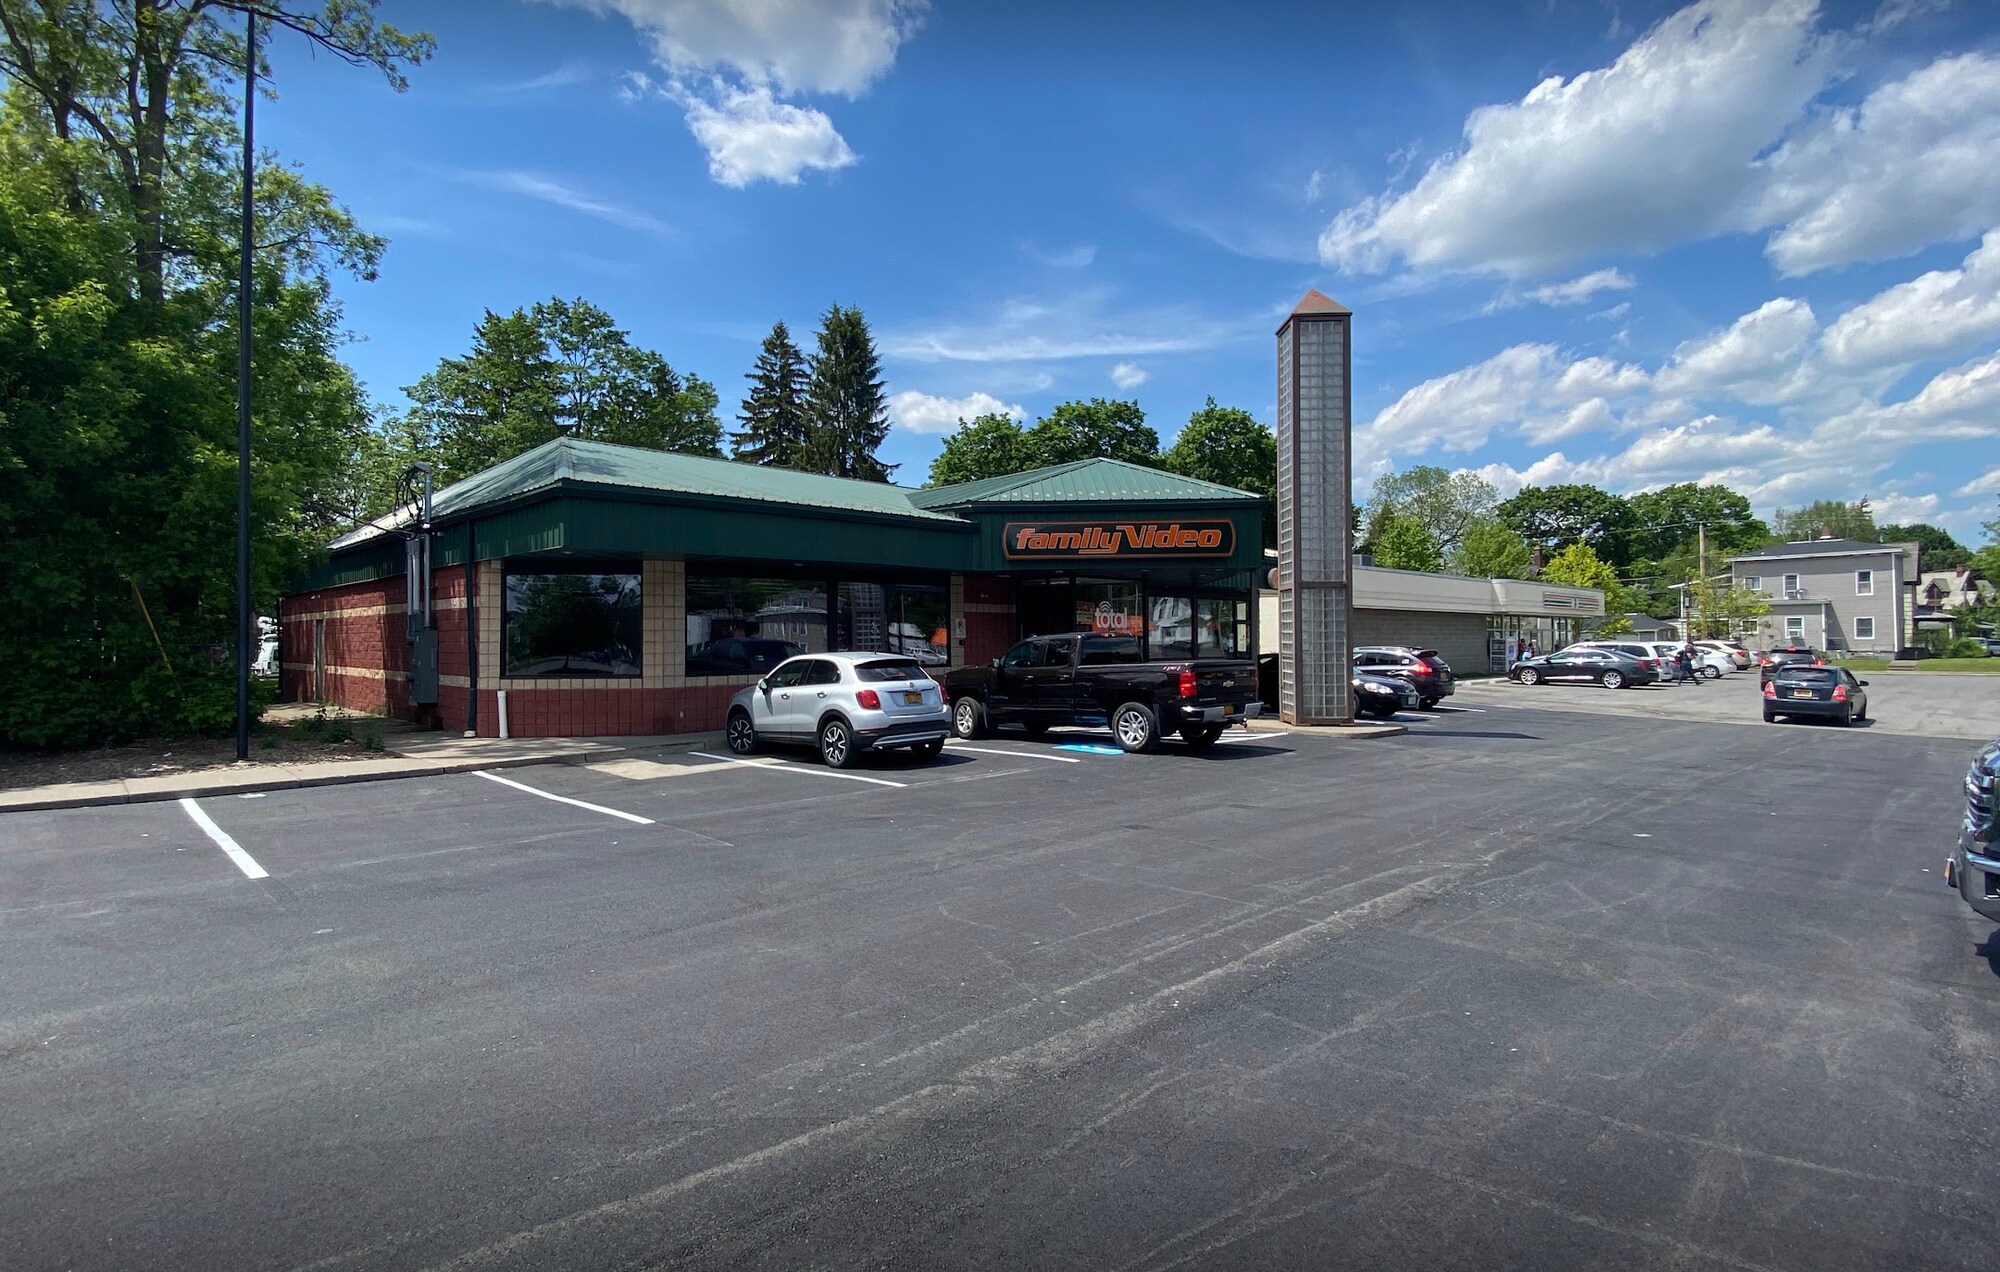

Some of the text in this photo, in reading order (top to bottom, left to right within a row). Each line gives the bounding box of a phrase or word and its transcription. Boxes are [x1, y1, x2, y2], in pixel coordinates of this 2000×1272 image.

[1016, 524, 1222, 554] family Video
[1095, 607, 1127, 629] total
